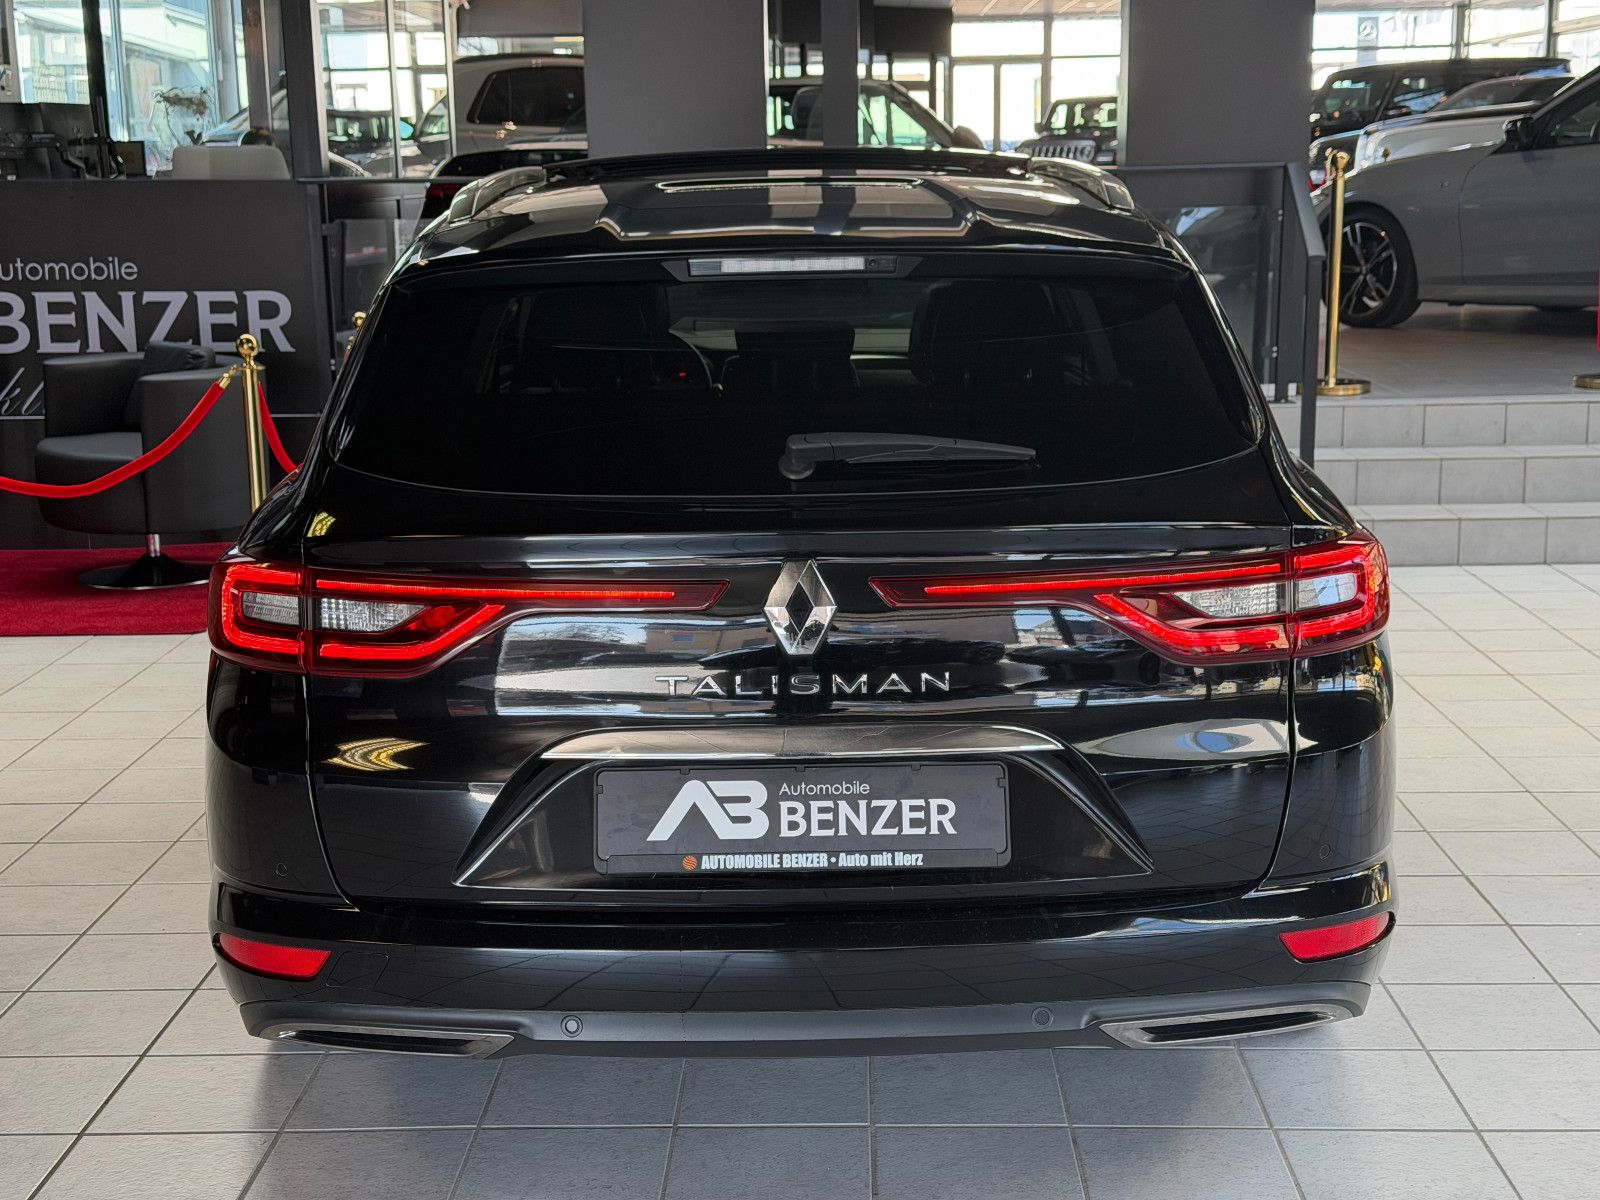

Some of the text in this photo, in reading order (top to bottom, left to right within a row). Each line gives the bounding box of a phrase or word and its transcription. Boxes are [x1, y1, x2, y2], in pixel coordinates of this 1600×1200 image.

[655, 671, 950, 696] TALISMAN
[779, 781, 870, 796] Automobile
[779, 799, 958, 838] BENZER
[701, 851, 924, 869] AUTOMOBILE BENZER Auto mit Herz
